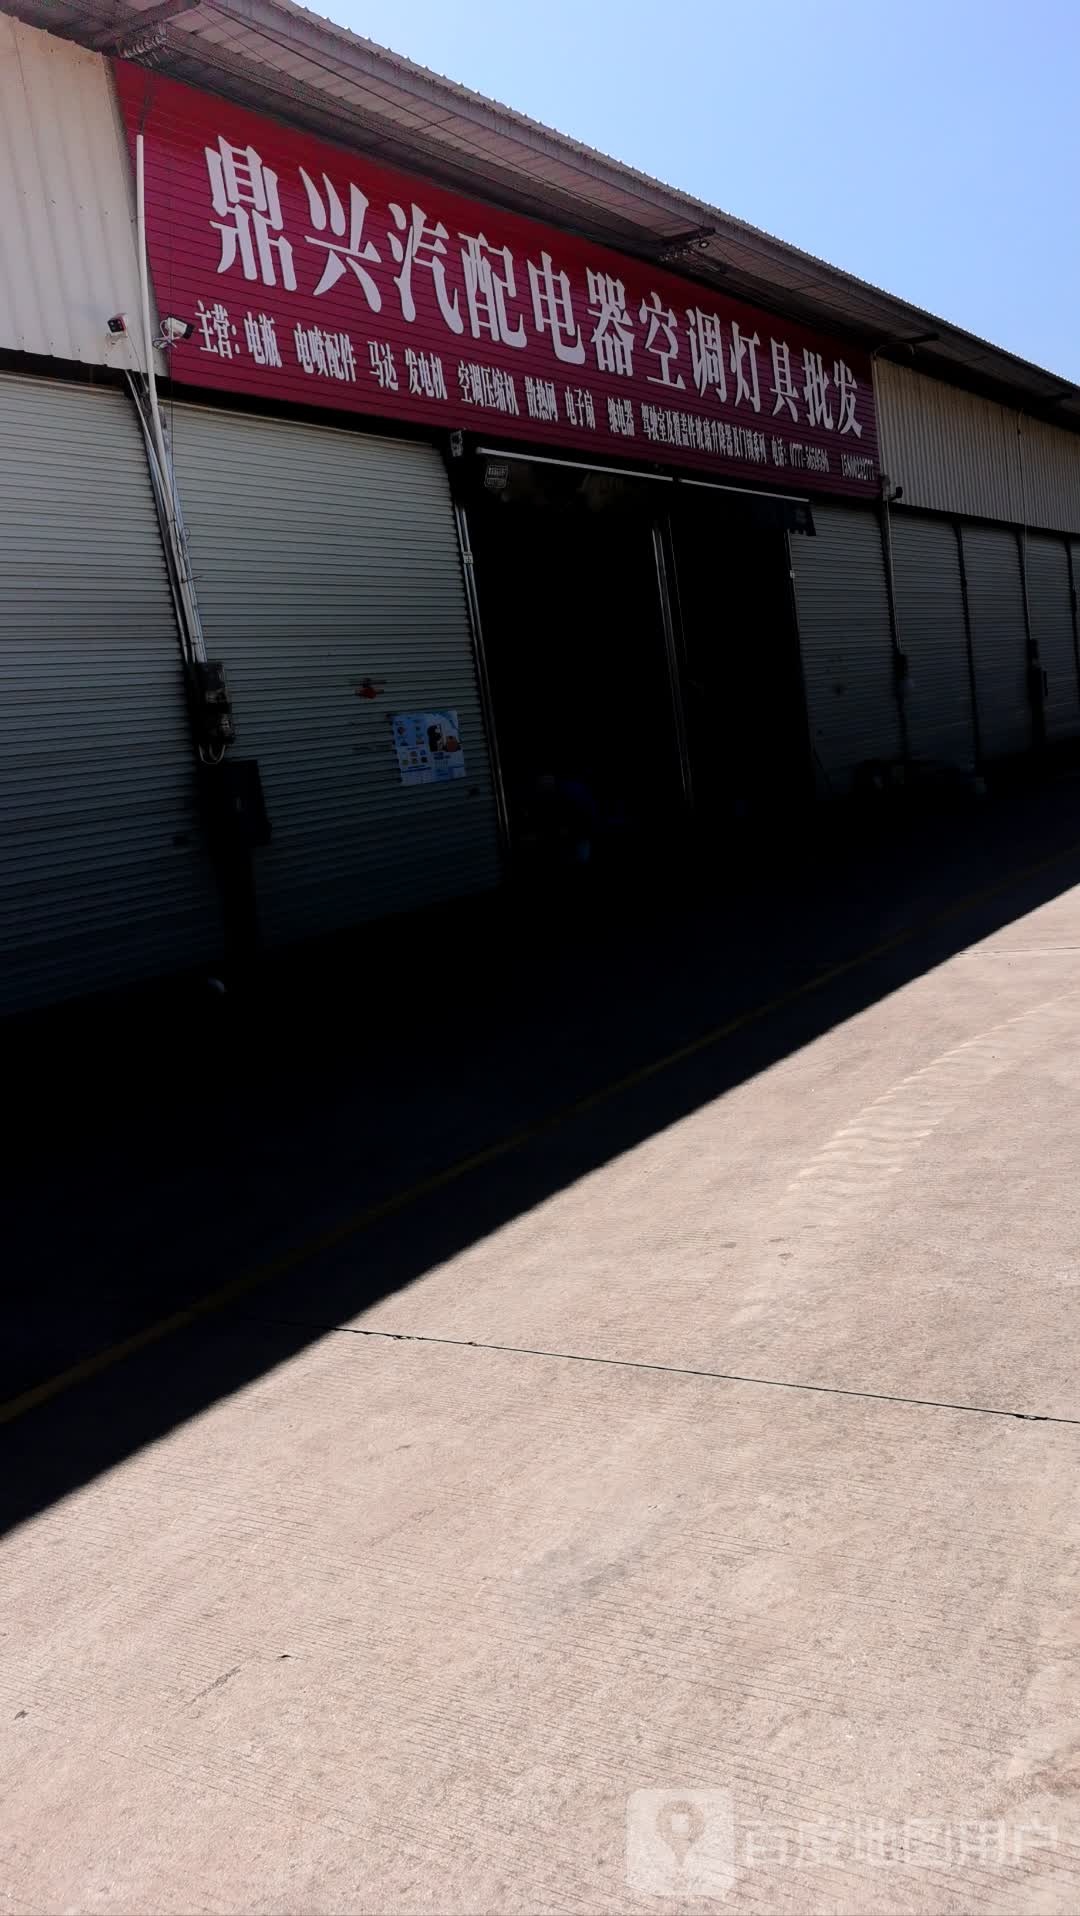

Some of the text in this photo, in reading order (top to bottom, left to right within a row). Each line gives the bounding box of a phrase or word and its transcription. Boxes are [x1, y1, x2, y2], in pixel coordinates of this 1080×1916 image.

[204, 136, 863, 439] 鼎兴汽配电器空调灯具批发
[294, 323, 357, 382] 电喷配件
[367, 340, 399, 391] 马达
[405, 347, 448, 400] 发电机
[457, 360, 520, 416] 空调压缩机
[525, 376, 559, 423] 散热网
[564, 386, 596, 430] 电子扇
[608, 396, 635, 437] 继电器
